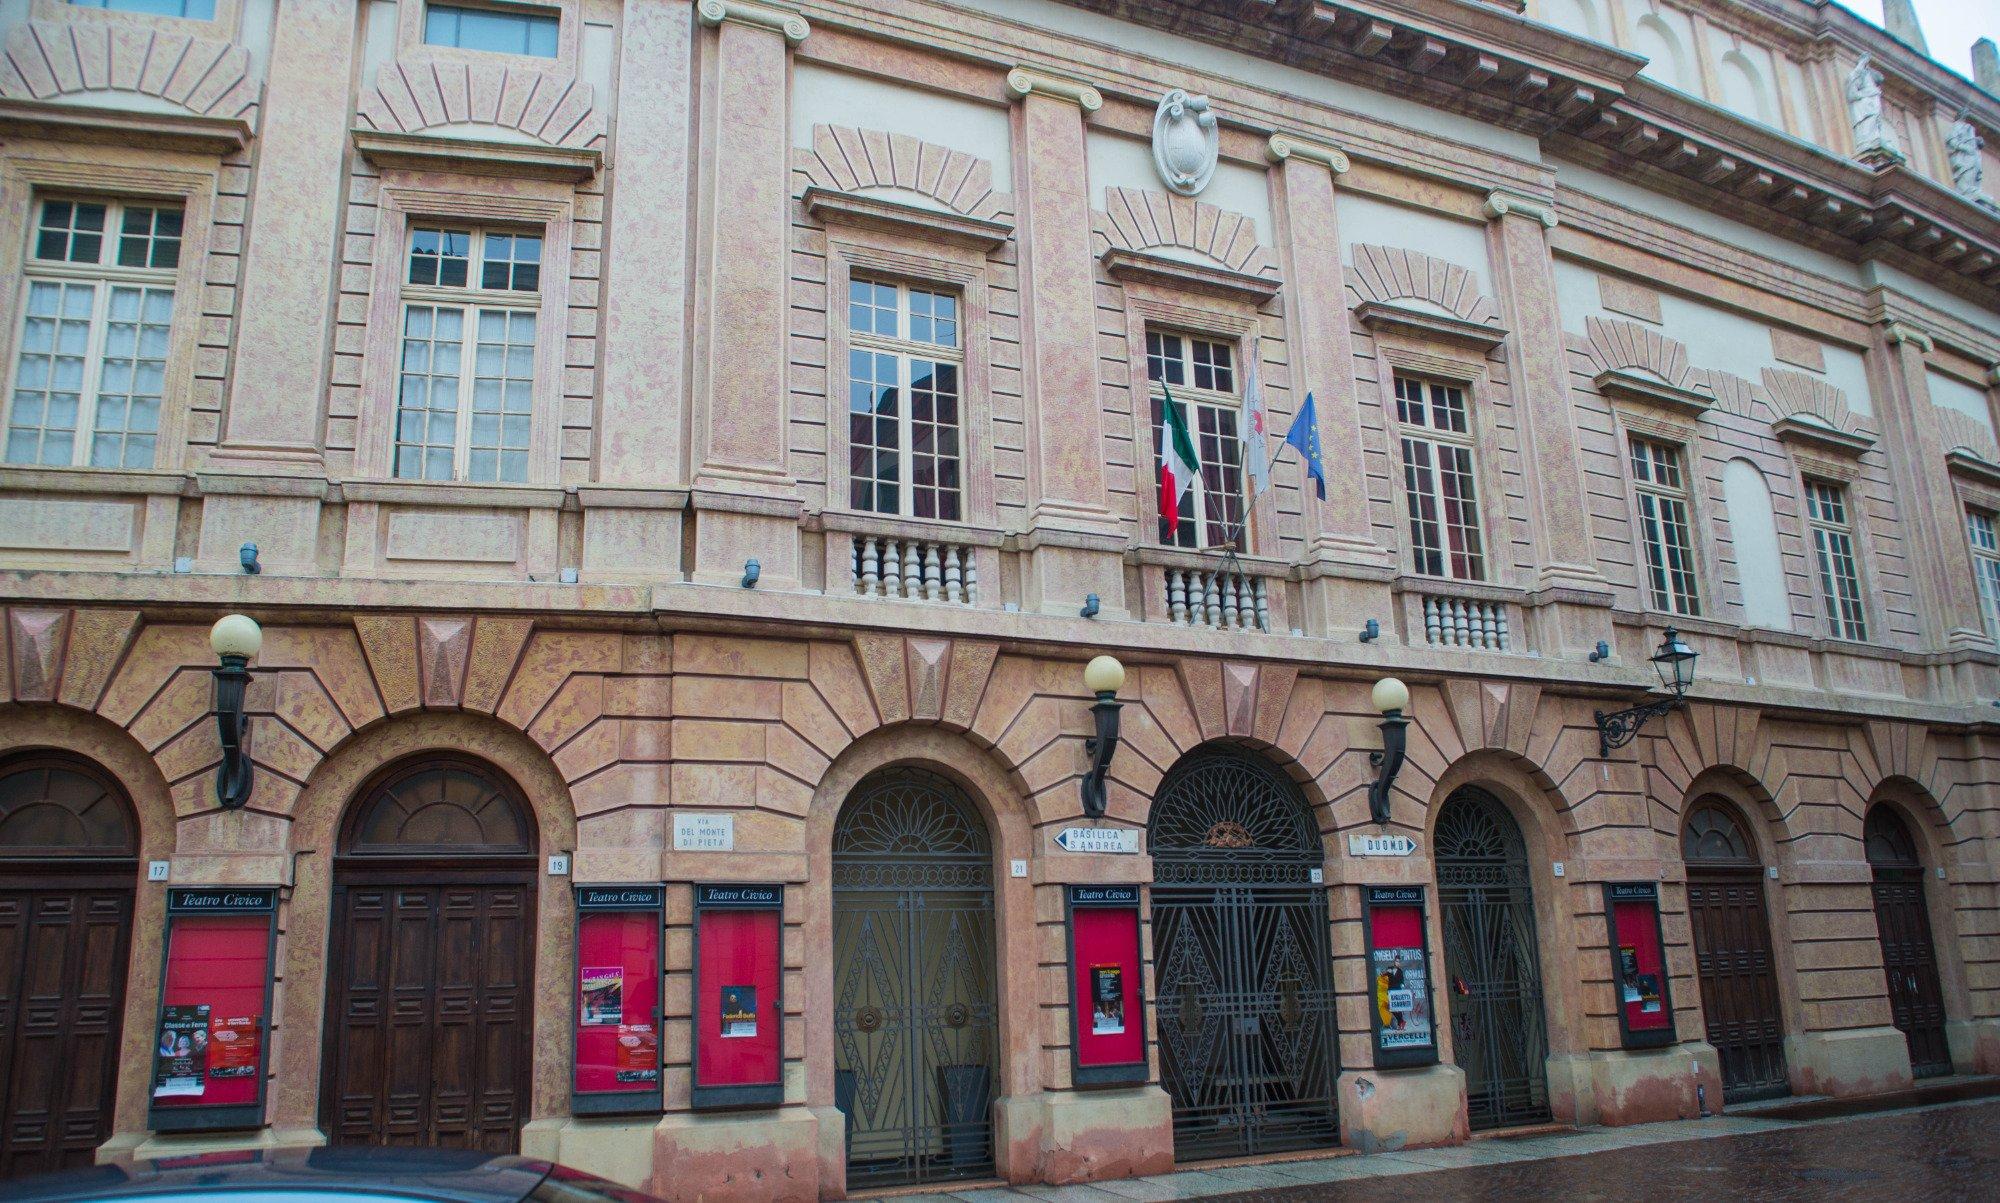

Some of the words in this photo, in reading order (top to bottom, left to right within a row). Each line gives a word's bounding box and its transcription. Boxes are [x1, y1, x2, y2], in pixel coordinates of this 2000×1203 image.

[681, 828, 695, 836] DEL
[699, 828, 726, 836] MONTE
[1073, 829, 1119, 840] BASILICA
[683, 838, 692, 846] DI
[1368, 840, 1404, 851] DUOMO
[553, 861, 562, 870] 19
[1015, 864, 1022, 874] 21
[154, 866, 164, 876] 17
[708, 888, 739, 900] Teatro
[741, 889, 773, 900] Civico
[1078, 889, 1104, 900] Teatro
[1106, 889, 1131, 900] Civico
[1374, 890, 1394, 899] Teatro
[1396, 890, 1417, 899] Civico
[1616, 886, 1633, 895] Teatro
[1633, 886, 1651, 894] Civico
[182, 892, 220, 906] Teatro
[223, 893, 262, 906] Civico
[588, 891, 618, 902] Teatro
[621, 891, 652, 902] Civico
[1388, 1032, 1426, 1040] VERCELLI
